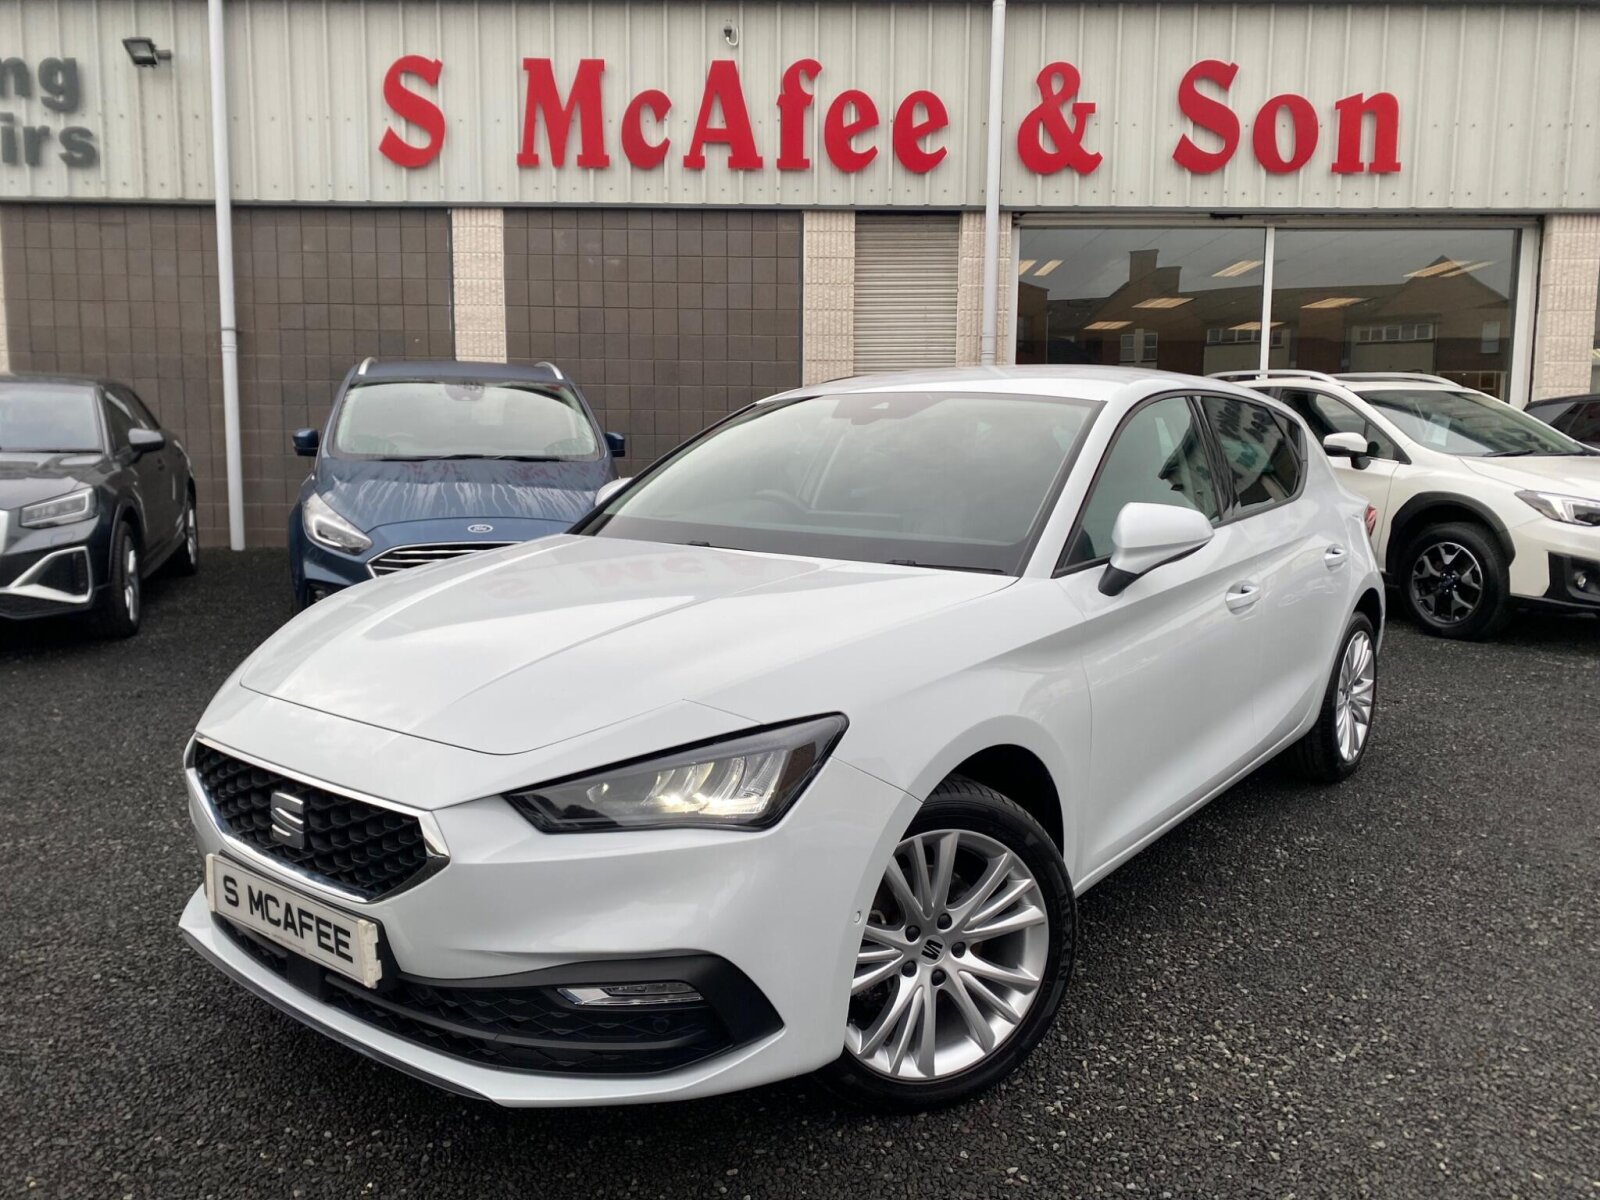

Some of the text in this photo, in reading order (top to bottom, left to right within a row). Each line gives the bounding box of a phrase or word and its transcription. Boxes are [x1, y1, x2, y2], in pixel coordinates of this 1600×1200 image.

[379, 55, 1401, 175] S McAfee & Son
[223, 875, 354, 964] S MCAFEE
[1058, 895, 1073, 979] NEXEN
